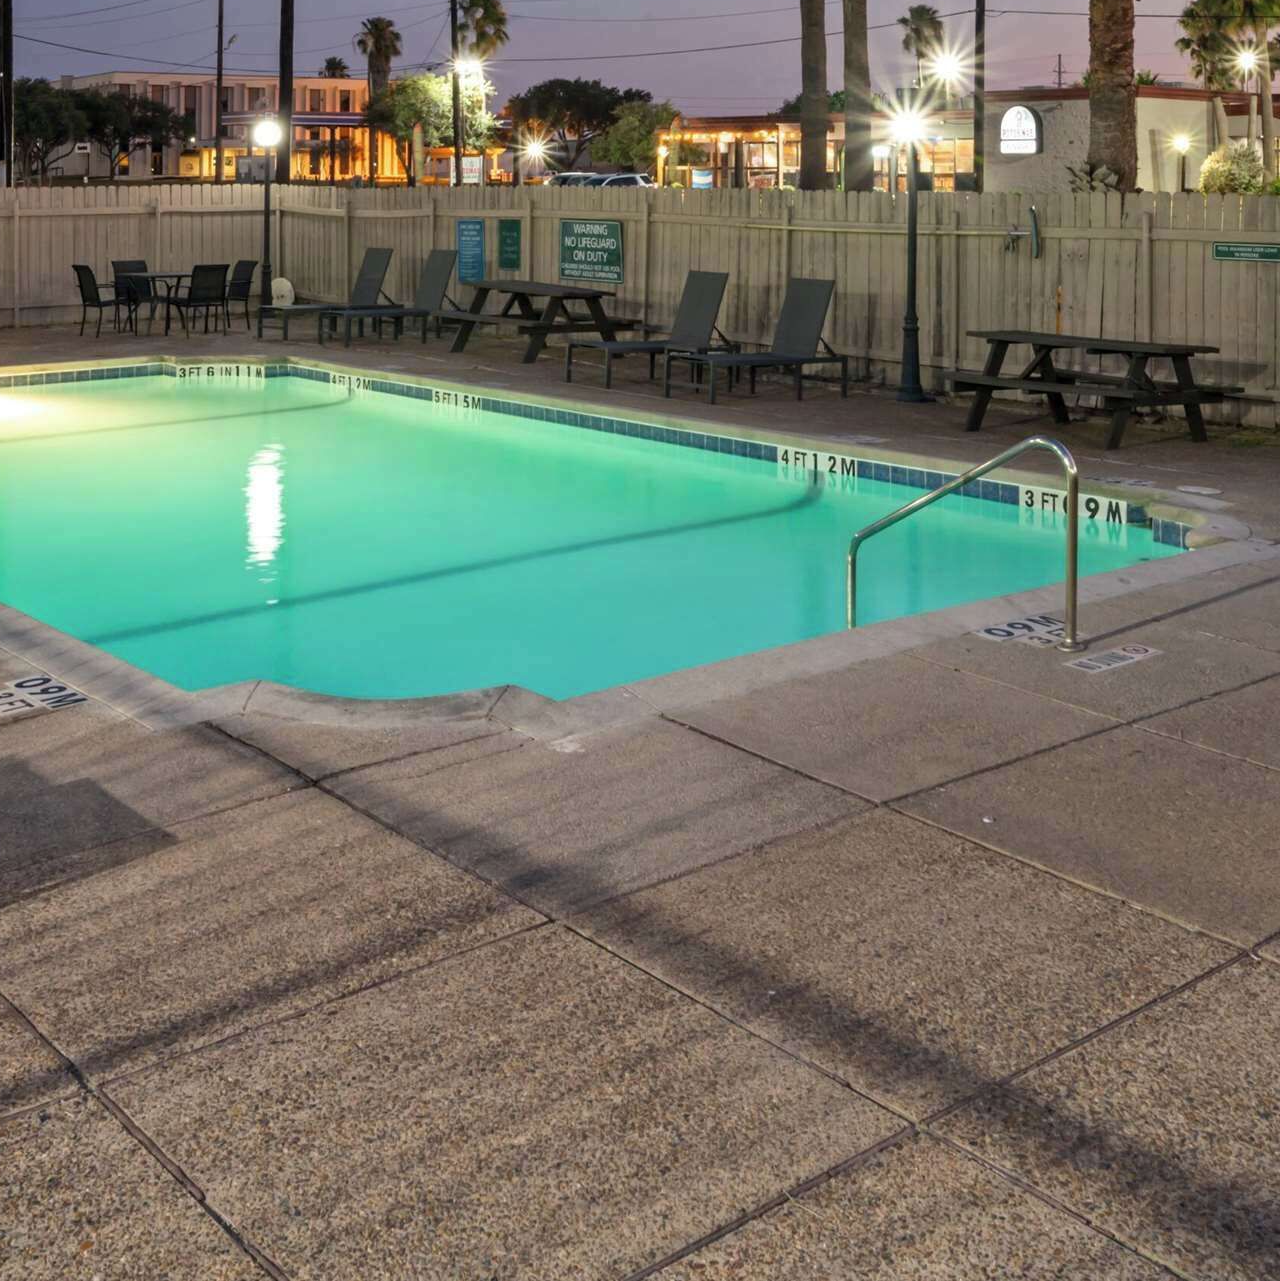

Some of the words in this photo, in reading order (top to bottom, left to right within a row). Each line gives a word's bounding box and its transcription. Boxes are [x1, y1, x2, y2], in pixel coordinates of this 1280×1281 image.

[573, 223, 608, 236] WARNING
[564, 236, 577, 248] NO
[577, 237, 617, 250] LIFEGUARD
[573, 250, 585, 261] ON
[587, 251, 608, 263] DUTY
[178, 367, 186, 378] 3
[188, 366, 201, 377] FT
[207, 366, 215, 377] 6
[220, 366, 232, 377] IN
[442, 391, 451, 405] FT
[781, 449, 789, 465] 4
[793, 451, 807, 469] FT
[1024, 489, 1034, 508] 3
[1041, 492, 1059, 513] FT
